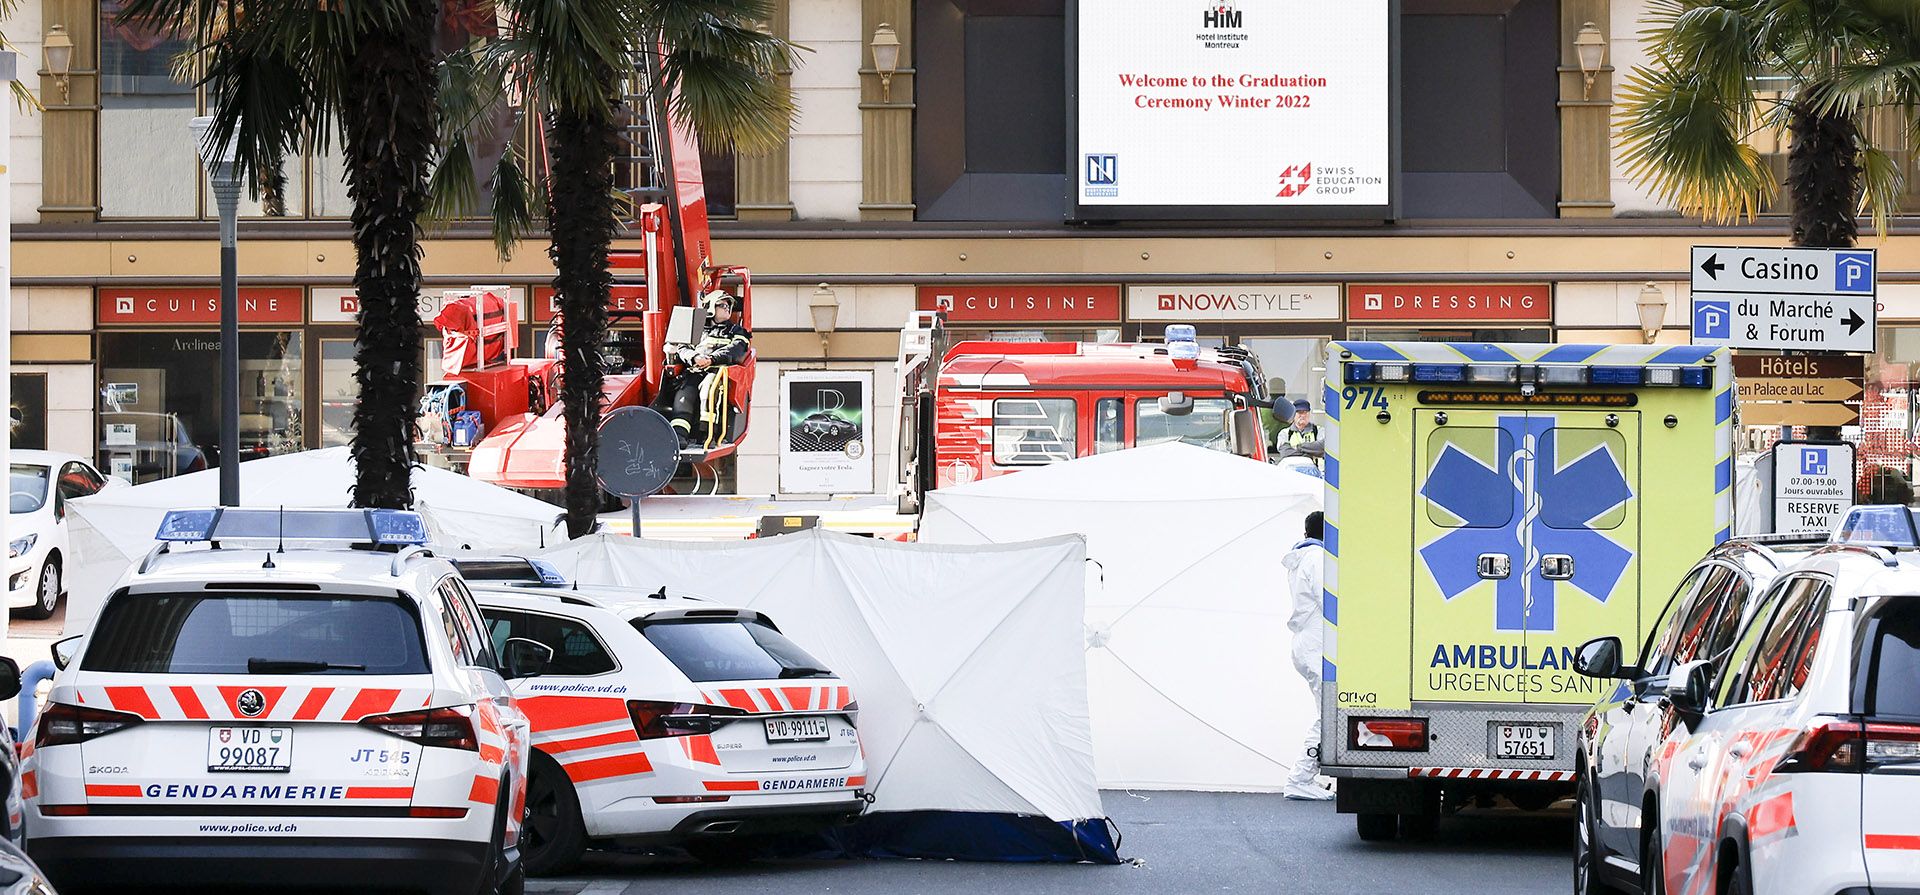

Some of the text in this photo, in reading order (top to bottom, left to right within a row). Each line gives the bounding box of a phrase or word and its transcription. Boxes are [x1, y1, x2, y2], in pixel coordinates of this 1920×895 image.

[1196, 33, 1249, 41] Hotel Institute
[1205, 41, 1240, 49] Montreux
[1118, 73, 1327, 88] Welcome to the Graduation
[1134, 94, 1311, 111] Ceremony Winter 2022
[1316, 166, 1355, 175] SWISS
[1316, 177, 1382, 185] EDUCATION
[1316, 187, 1356, 195] GROUP
[1741, 257, 1819, 281] Casino
[146, 298, 277, 312] CUISNE
[966, 296, 1095, 310] CUISINE
[1178, 294, 1301, 311] NOVASTYLE
[1394, 295, 1534, 309] DRESSING
[1737, 299, 1759, 317] du
[1769, 300, 1834, 318] Marché
[1746, 323, 1825, 342] & Forum
[1760, 357, 1818, 375] Hôtels
[1754, 382, 1788, 396] Palace
[1790, 385, 1804, 396] au
[1806, 382, 1825, 396] Lac
[1342, 386, 1389, 410] 974
[1790, 477, 1837, 487] 07.00-19.00
[1784, 487, 1844, 496] Jours ouvrables
[1788, 502, 1840, 514] RESERVE
[1801, 516, 1828, 527] TAXI
[1430, 644, 1581, 670] AMBULAN
[530, 683, 628, 694] www.police.vd.ch
[1429, 673, 1543, 693] URGENCES
[242, 729, 261, 744] VD
[1519, 727, 1533, 739] VD
[1504, 741, 1546, 755] 57651
[220, 747, 280, 766] 99087
[351, 749, 410, 764] JT 545
[772, 754, 817, 763] www.police.vd.ch
[763, 777, 845, 791] GENDARMERIE
[146, 783, 344, 800] GENDARMERIE
[199, 823, 298, 834] www.police.vd.ch
